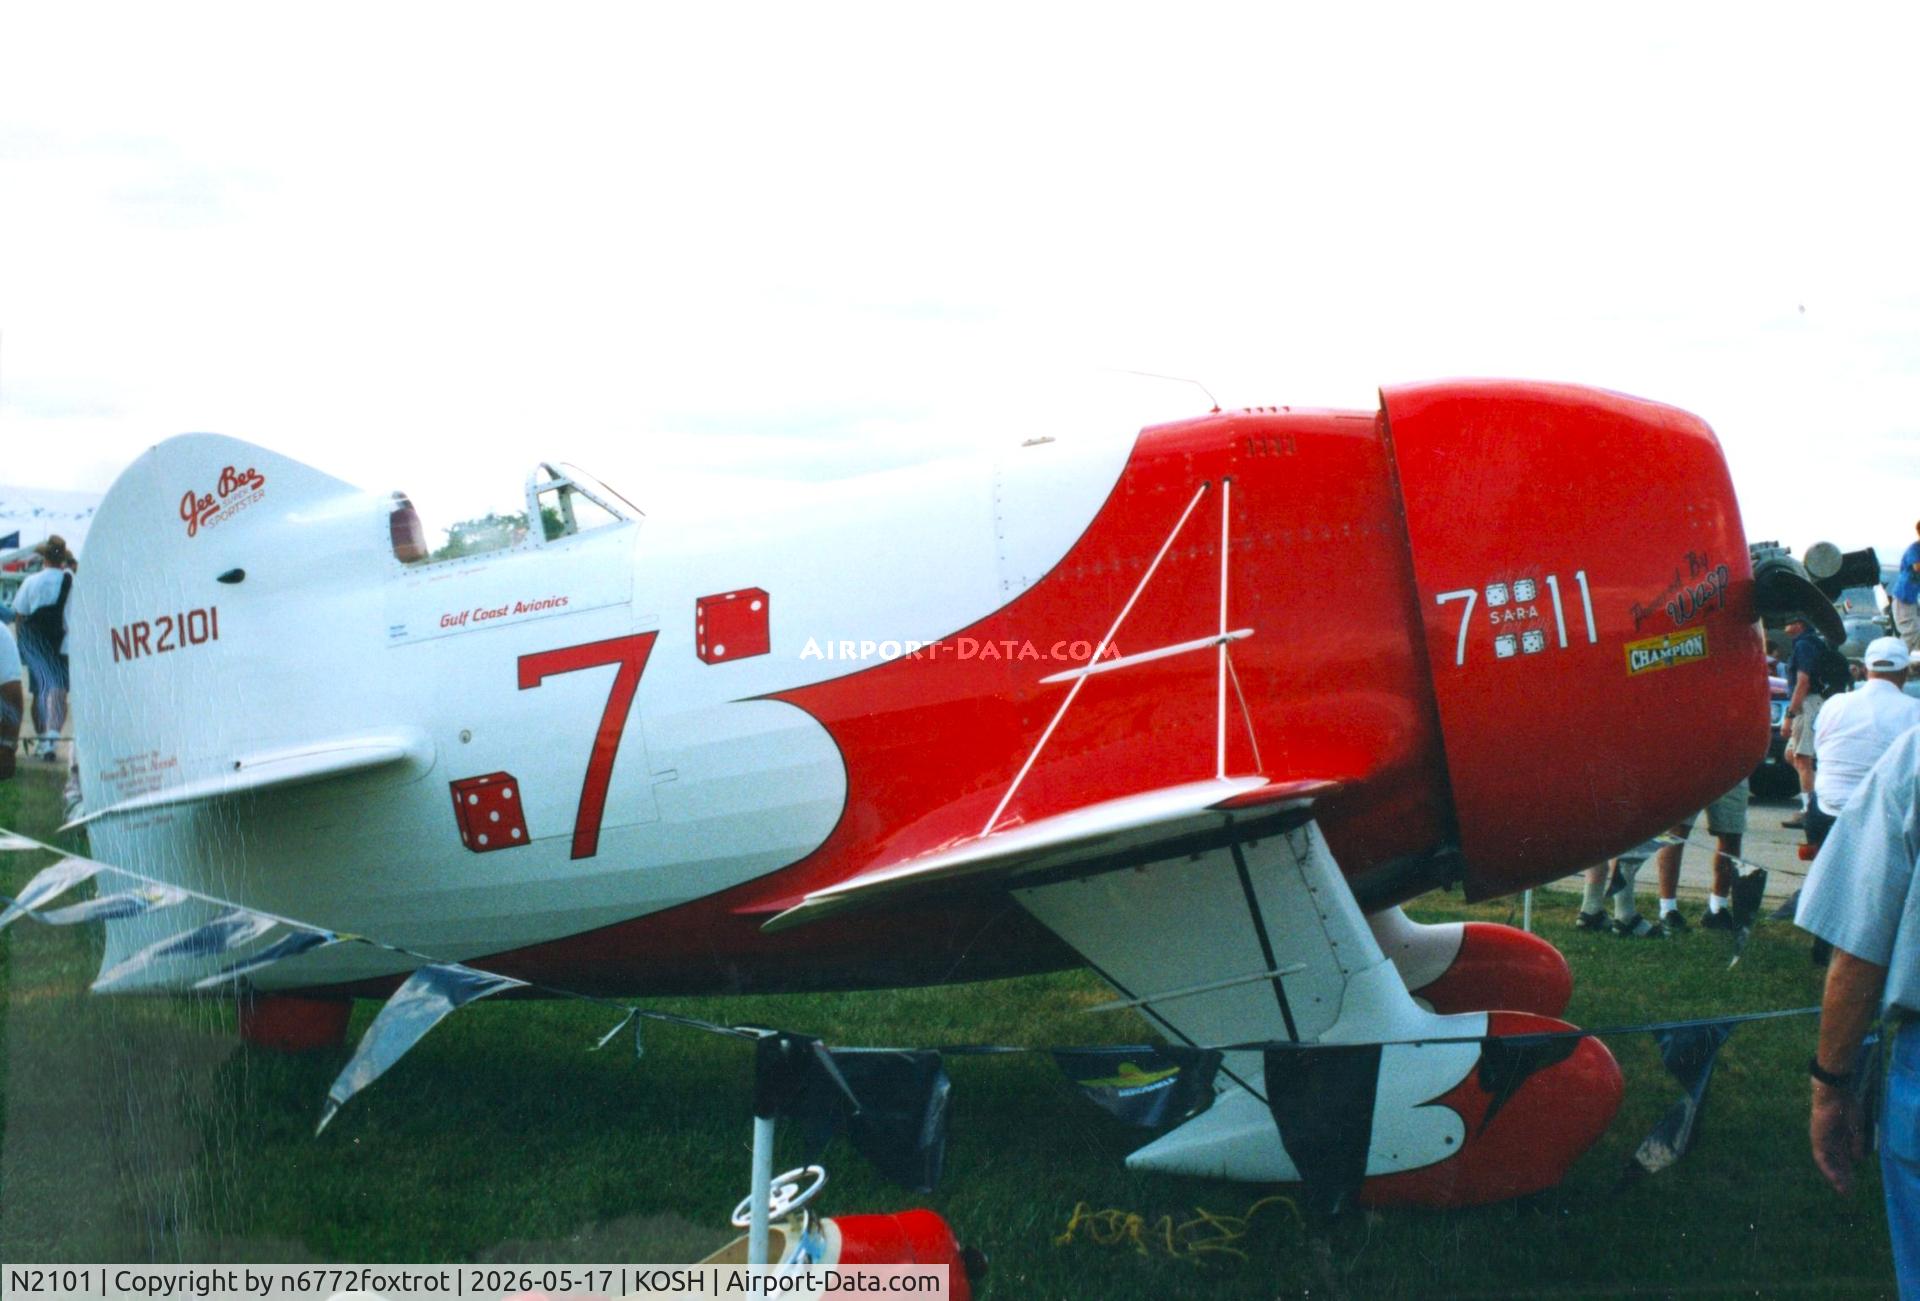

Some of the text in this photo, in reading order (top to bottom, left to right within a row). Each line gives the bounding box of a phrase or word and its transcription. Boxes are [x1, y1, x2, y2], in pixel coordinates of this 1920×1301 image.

[217, 466, 265, 498] Bee
[207, 489, 265, 529] SPORTSTER
[440, 595, 569, 628] Gulf Coast Avionics
[1435, 569, 1598, 667] 7 11
[1665, 563, 1729, 626] Wasp
[111, 606, 219, 663] NR2101
[1631, 634, 1704, 671] CHAMPION
[517, 630, 660, 860] 7
